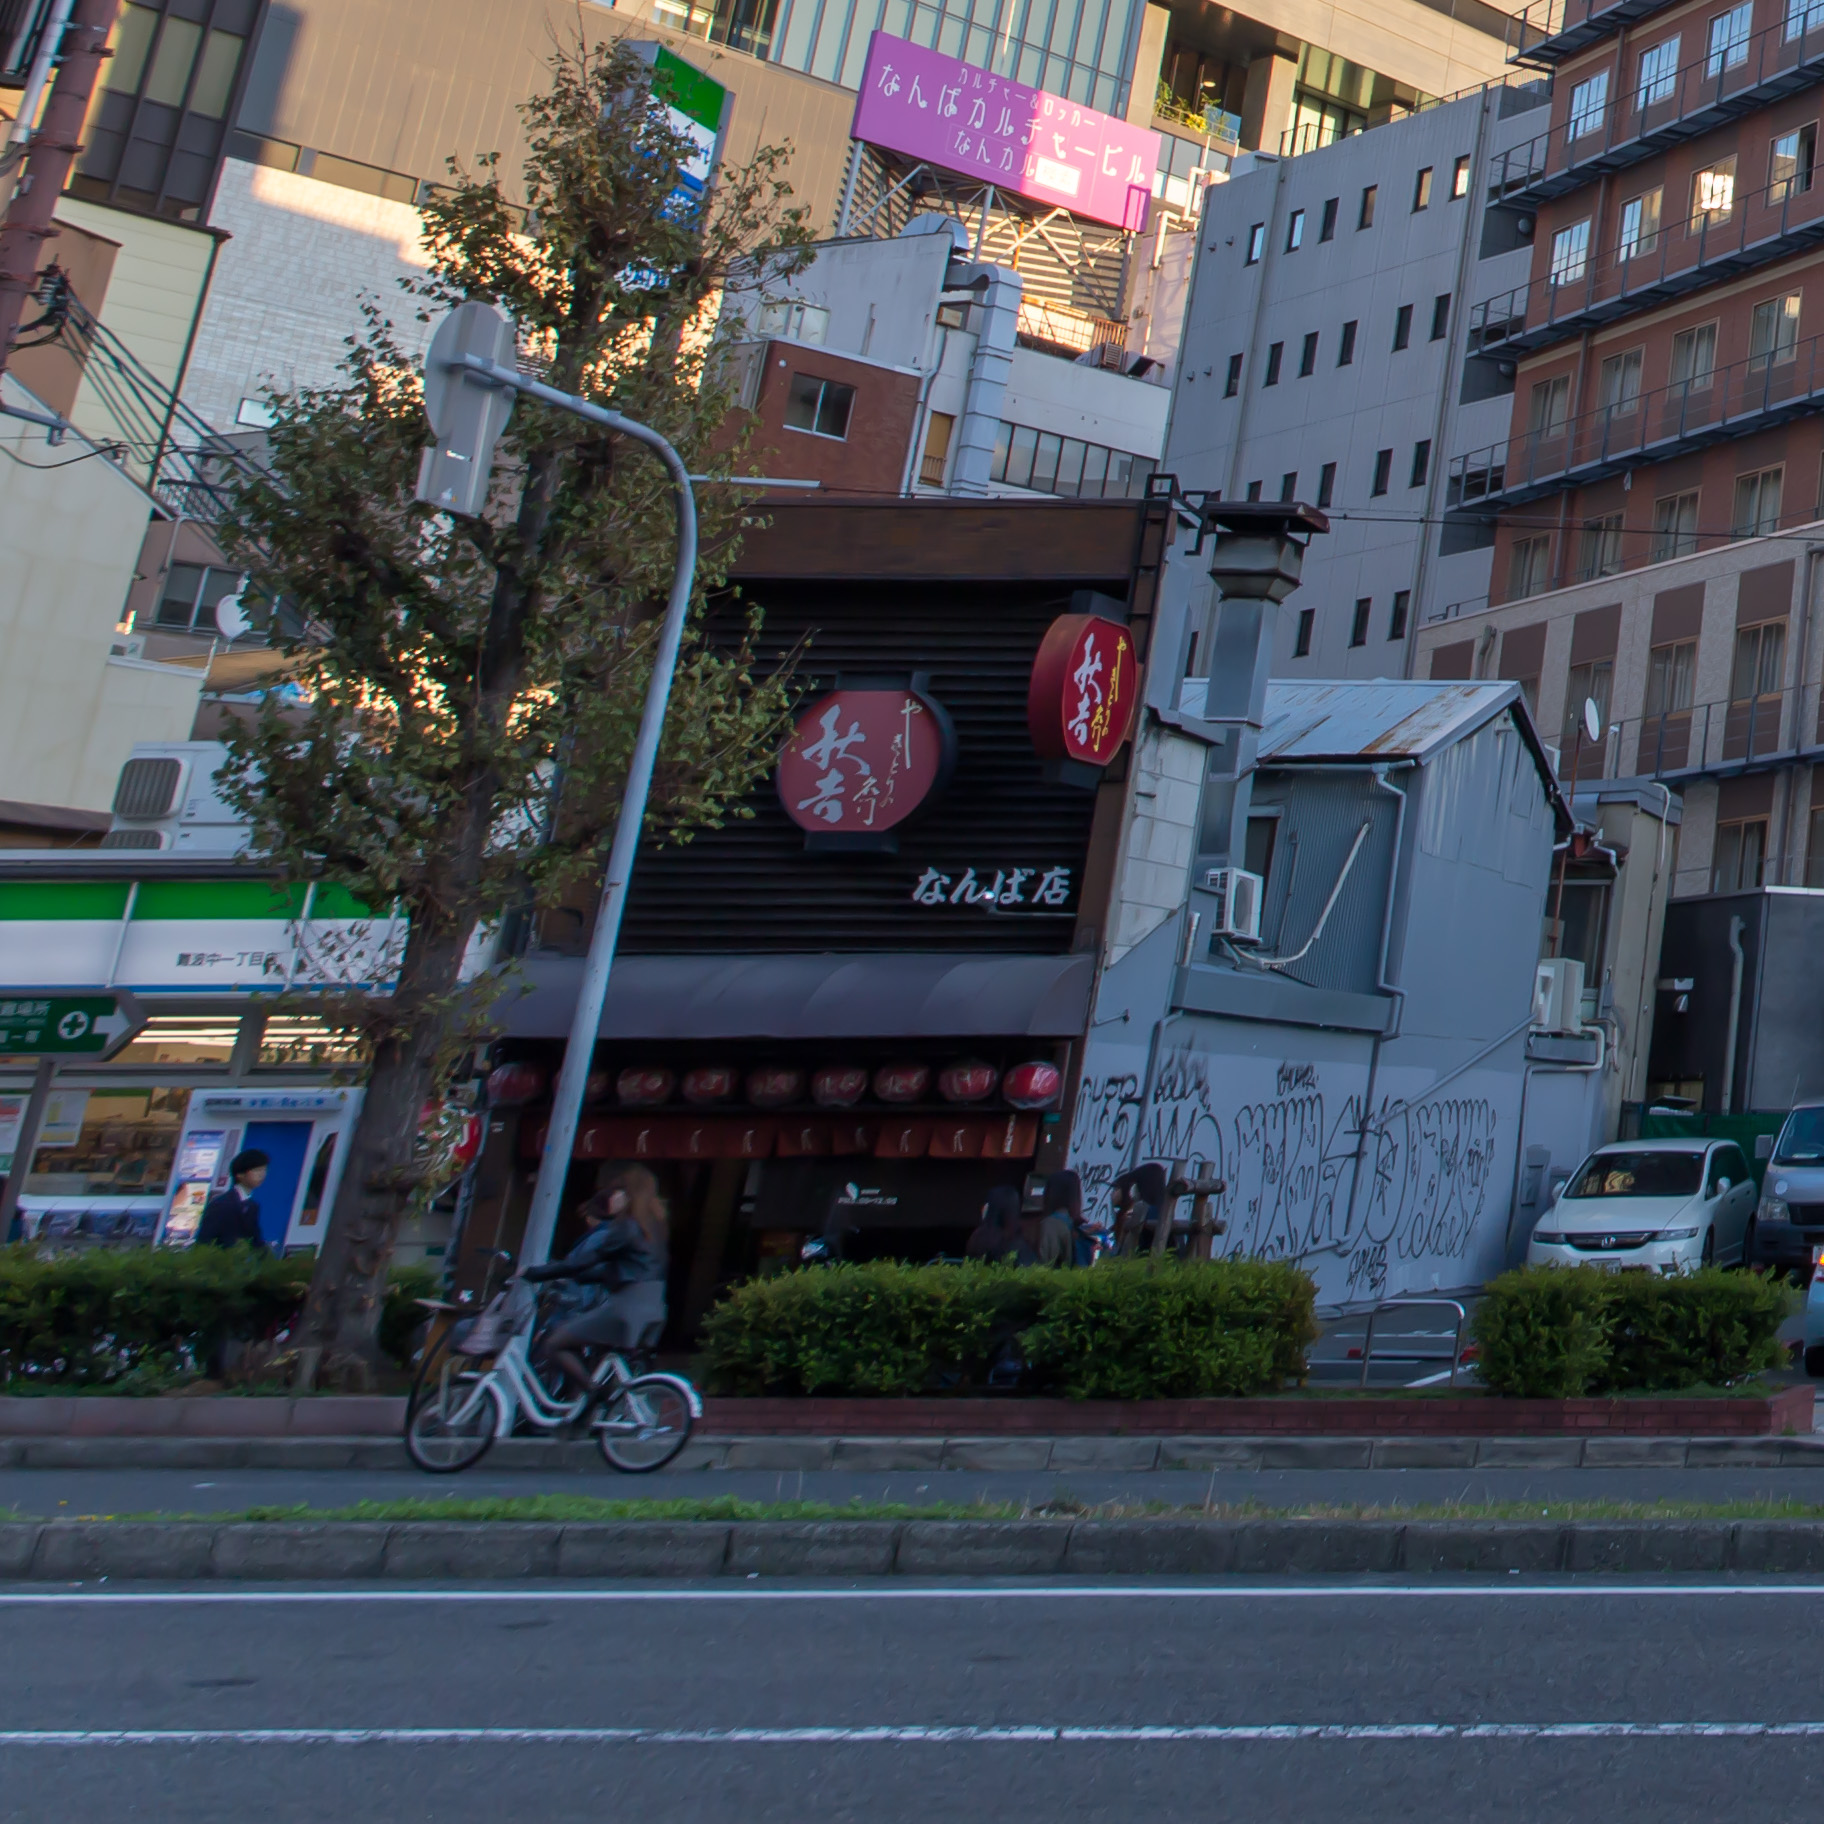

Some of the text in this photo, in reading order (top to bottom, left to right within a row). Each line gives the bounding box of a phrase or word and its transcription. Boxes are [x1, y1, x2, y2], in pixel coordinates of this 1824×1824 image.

[953, 129, 1036, 178] なんカル
[796, 703, 871, 824] 秋吉
[911, 865, 1072, 906] なんば店
